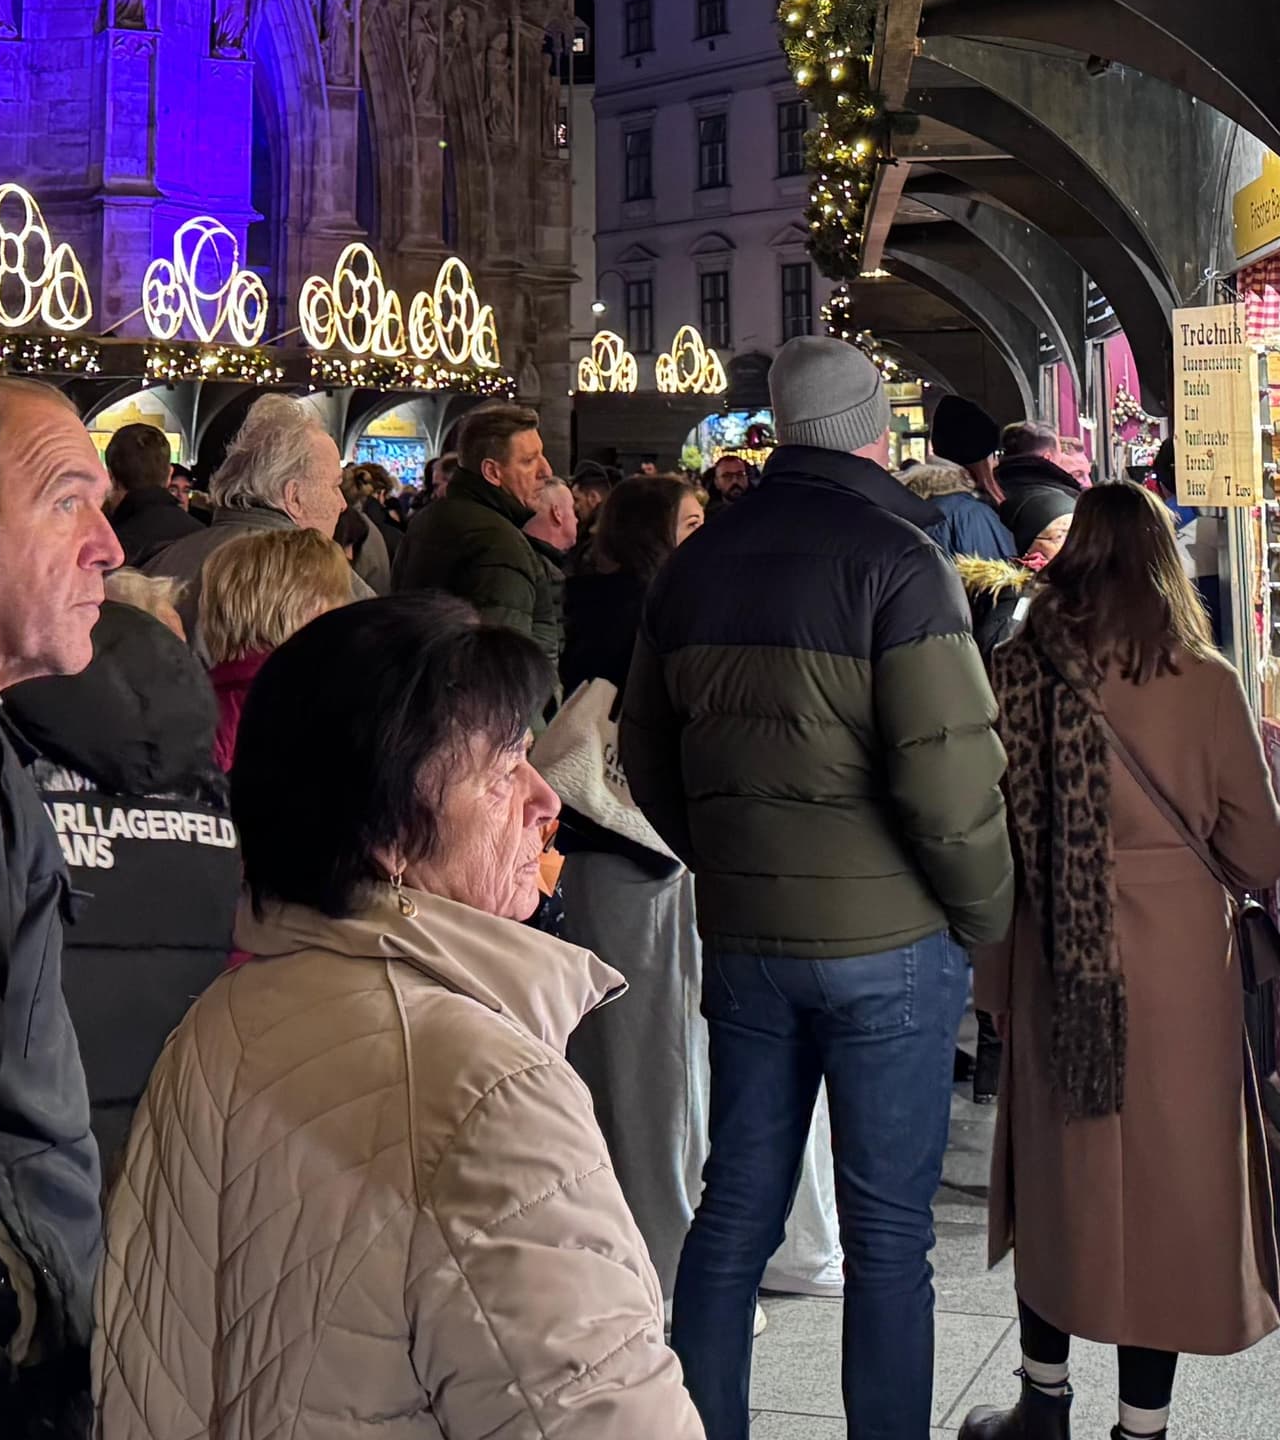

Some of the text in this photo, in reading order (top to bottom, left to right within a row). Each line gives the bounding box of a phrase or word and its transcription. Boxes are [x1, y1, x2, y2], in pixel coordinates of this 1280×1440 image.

[1181, 322, 1242, 346] Trdelnik
[1224, 476, 1231, 496] 7
[93, 806, 237, 849] LAGERFELD
